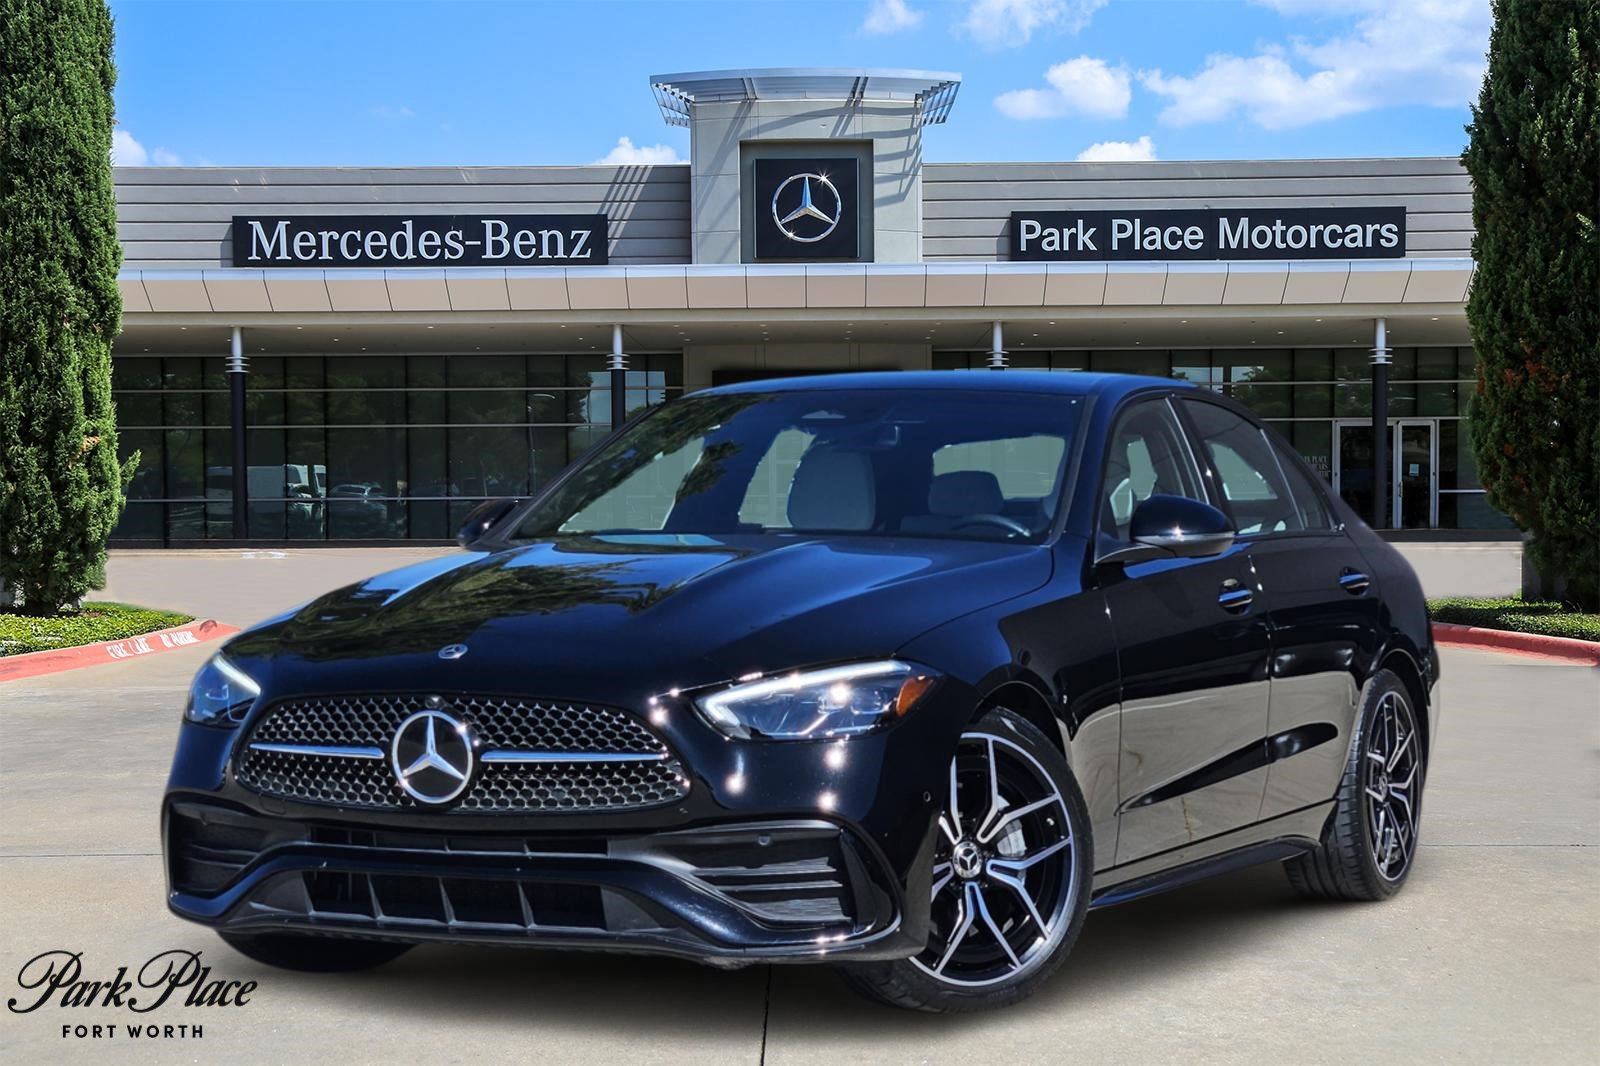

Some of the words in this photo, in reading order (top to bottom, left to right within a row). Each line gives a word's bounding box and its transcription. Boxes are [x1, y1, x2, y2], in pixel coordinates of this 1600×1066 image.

[247, 219, 592, 260] Mercedes-Benz
[1020, 219, 1098, 251] Park
[1111, 218, 1204, 251] Place
[1218, 217, 1399, 250] Motorcars
